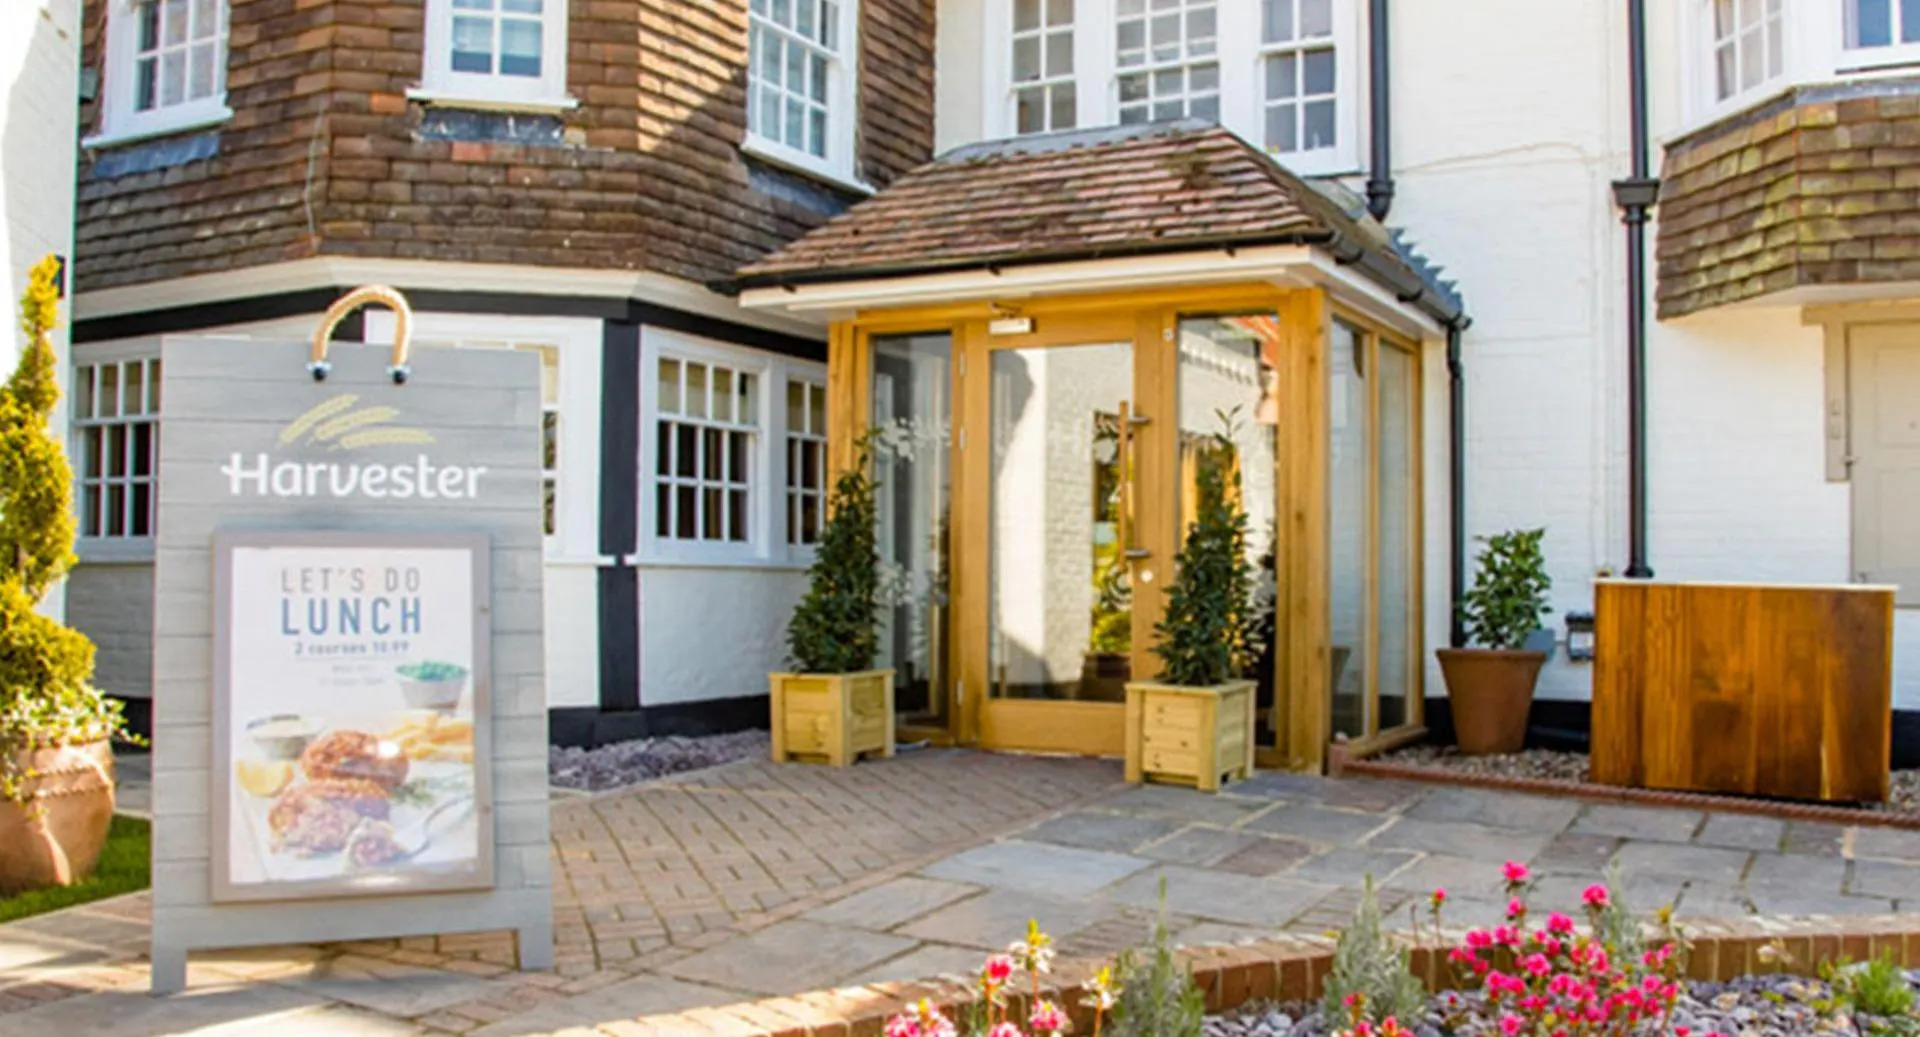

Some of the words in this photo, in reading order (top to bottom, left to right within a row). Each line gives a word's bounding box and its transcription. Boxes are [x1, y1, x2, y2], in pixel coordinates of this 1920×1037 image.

[220, 452, 489, 498] Harvester
[281, 567, 366, 593] LET'S
[384, 567, 421, 593] DO
[281, 597, 421, 635] LUNCH
